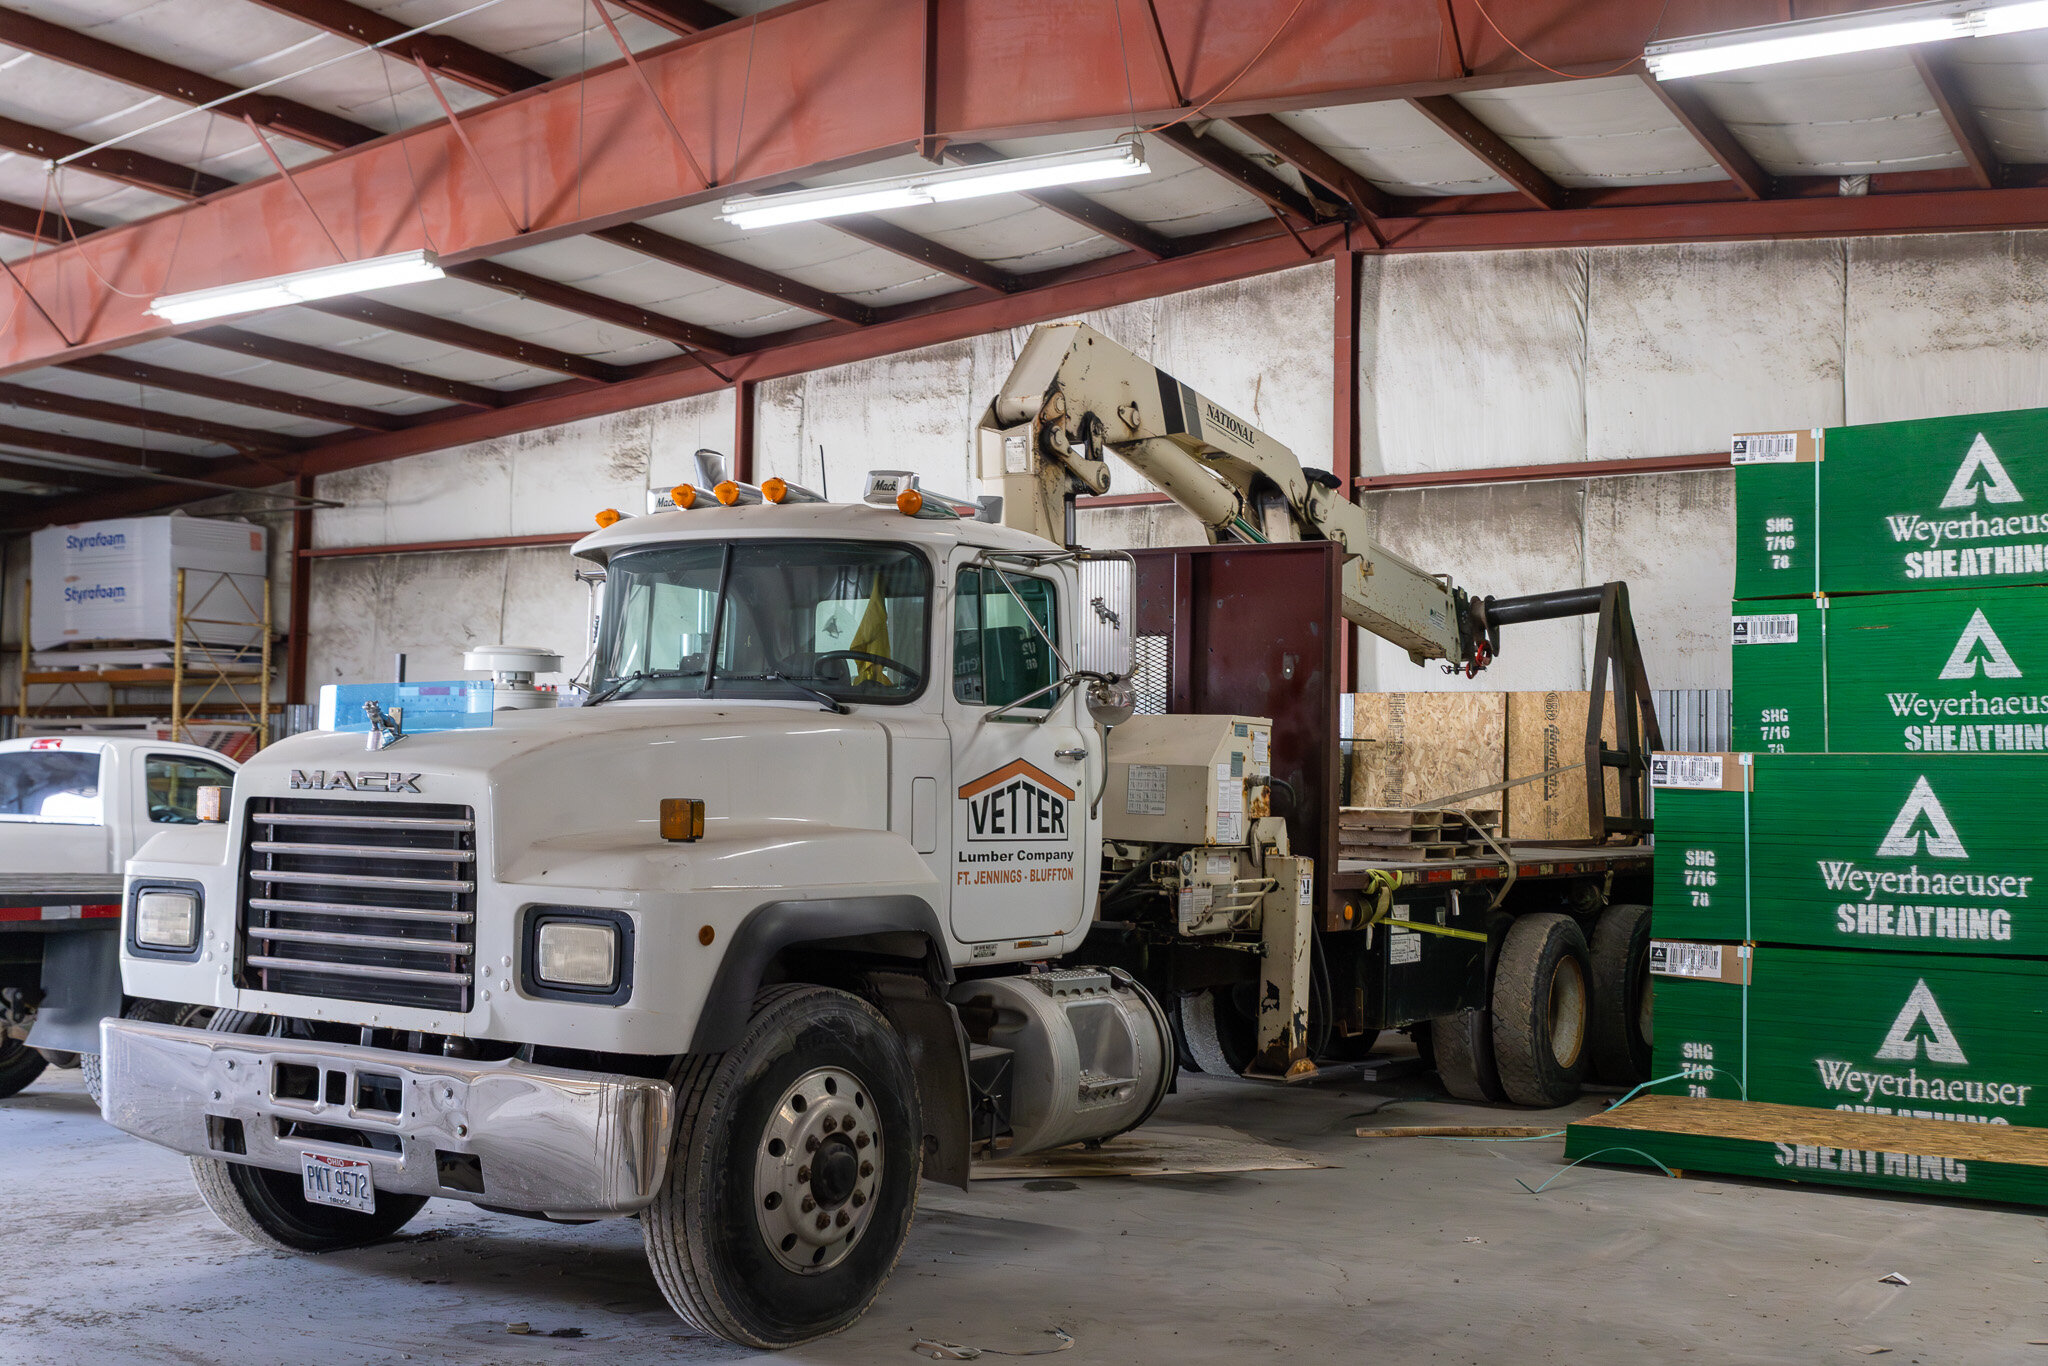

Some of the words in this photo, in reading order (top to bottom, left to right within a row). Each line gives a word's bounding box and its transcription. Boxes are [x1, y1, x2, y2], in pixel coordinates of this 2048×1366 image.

[1206, 403, 1255, 445] NATIONAL
[873, 480, 897, 491] Mack
[1766, 517, 1794, 532] SHG
[1885, 511, 2048, 548] Weyerhaeus
[66, 532, 126, 552] Styrofoam
[1765, 535, 1795, 551] 7/16
[1772, 554, 1790, 569] 78
[1904, 544, 2048, 579] SHEATHIN
[64, 584, 126, 605] Styrofoam
[1761, 708, 1788, 722] SHG
[1885, 689, 2048, 724] Weyerhaeus
[1760, 725, 1791, 740] 7/16
[1904, 724, 2048, 751] SHEATHIN
[290, 769, 422, 793] MACK
[970, 780, 1065, 835] VETTER
[958, 850, 1013, 862] Lumber
[1017, 849, 1074, 863] Company
[1685, 850, 1715, 866] SHG
[957, 871, 971, 885] FT.
[974, 869, 1022, 884] JENNINGS
[1030, 867, 1074, 882] BLUFFTON
[1684, 870, 1717, 887] 7/16
[1817, 861, 2033, 900] Weyerhaeuser
[1690, 891, 1710, 907] 78
[1837, 903, 2012, 941] SHEATHING
[1683, 1042, 1713, 1060] SHG
[1681, 1062, 1714, 1080] 7/16
[1814, 1058, 2032, 1106] Weyerhaeuser
[327, 1157, 345, 1168] OHIO
[307, 1165, 331, 1193] PKT
[335, 1169, 369, 1200] 9572
